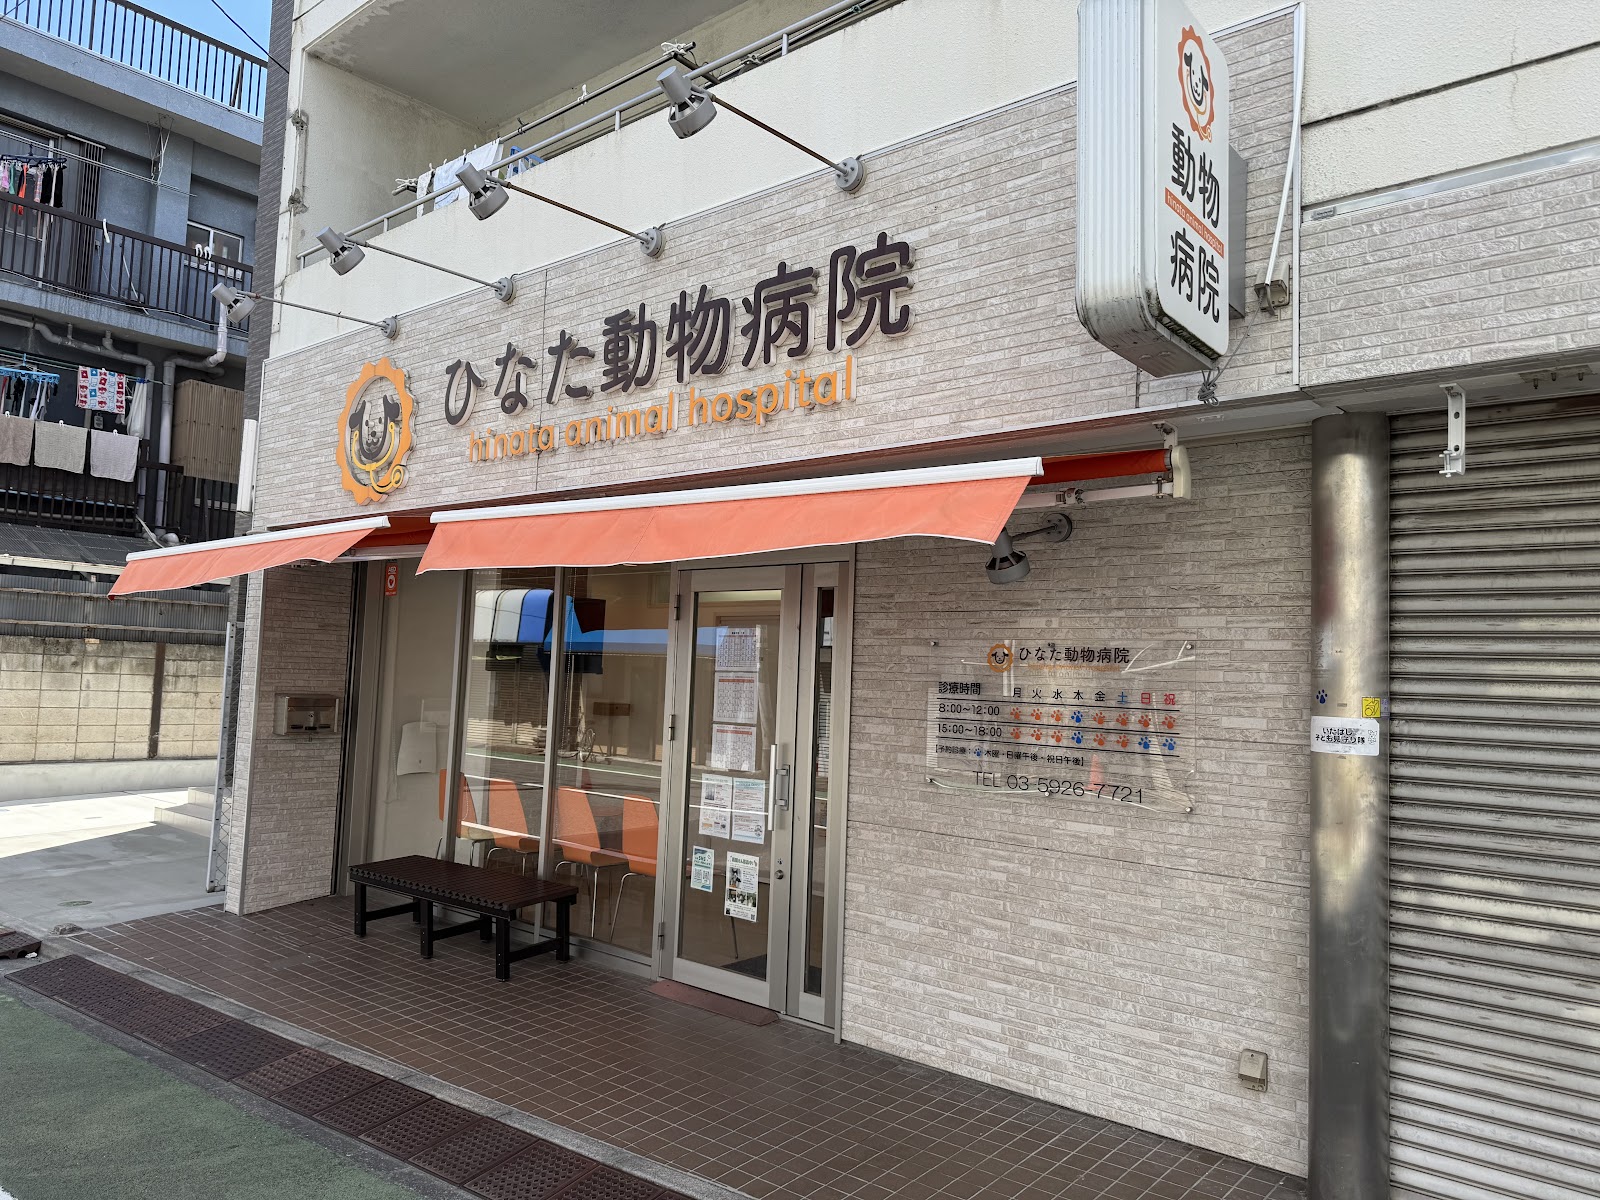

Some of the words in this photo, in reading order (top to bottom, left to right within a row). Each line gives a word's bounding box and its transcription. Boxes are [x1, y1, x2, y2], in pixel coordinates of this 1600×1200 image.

[1171, 122, 1220, 228] 動物
[1167, 191, 1186, 218] hinata
[1185, 213, 1204, 236] animal
[1170, 227, 1220, 324] 病院
[444, 231, 917, 426] ひなた動物病院
[468, 423, 555, 464] hinata
[565, 391, 679, 447] animal
[688, 354, 858, 427] hospital
[1019, 646, 1130, 664] ひなた動物病院
[938, 681, 981, 696] 診療時間
[1013, 687, 1022, 698] 月
[1032, 688, 1042, 699] 火
[1053, 689, 1063, 700] 水
[1073, 690, 1084, 700] 木
[1095, 690, 1106, 702] 金
[1117, 692, 1128, 704] 土
[1141, 692, 1151, 704] 日
[1164, 693, 1176, 705] 祝
[973, 771, 1000, 787] TEL
